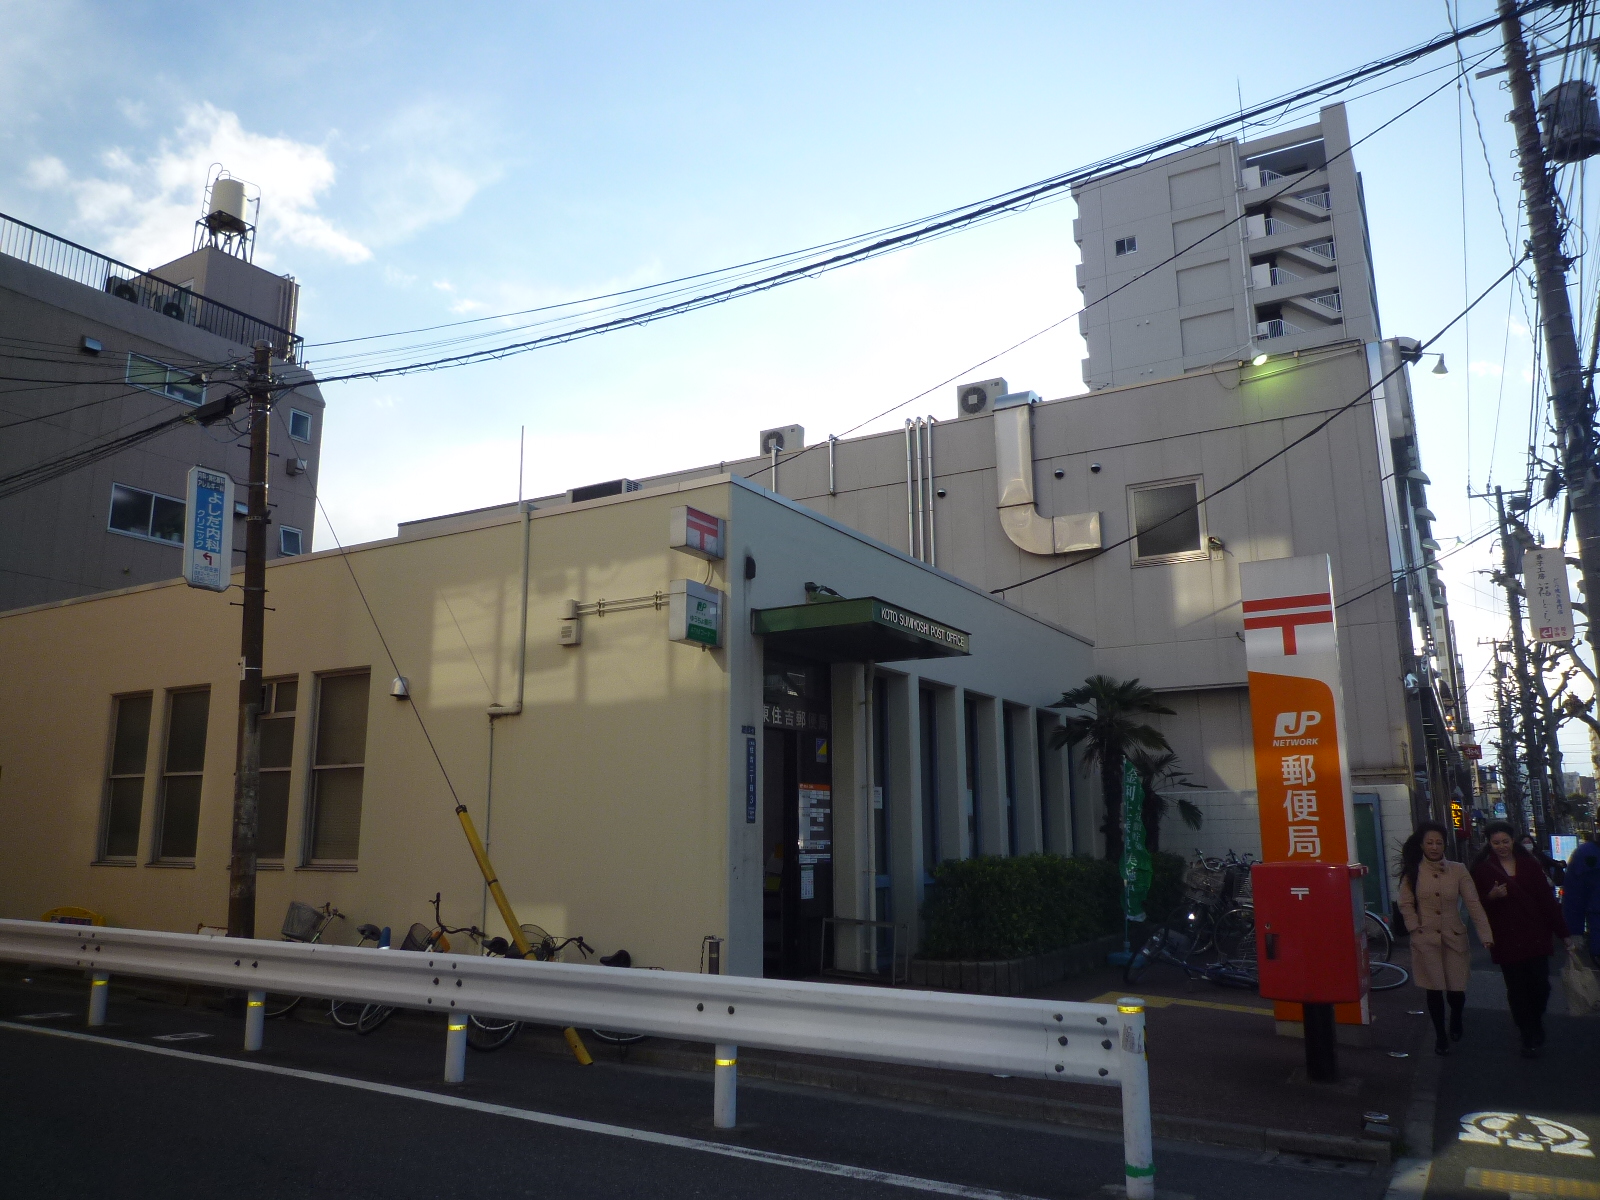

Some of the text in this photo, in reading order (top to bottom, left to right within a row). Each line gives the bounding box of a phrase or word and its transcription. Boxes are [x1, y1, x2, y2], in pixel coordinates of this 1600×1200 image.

[196, 509, 205, 548] クリニック
[205, 492, 222, 553] よしだ内科
[689, 615, 713, 627] ゆうちょ銀行
[881, 607, 898, 623] KOTO
[930, 625, 945, 640] POST
[946, 631, 965, 647] OFFICE
[1272, 737, 1319, 747] NETWORK
[1273, 710, 1322, 738] JP
[1281, 754, 1322, 858] 郵便局
